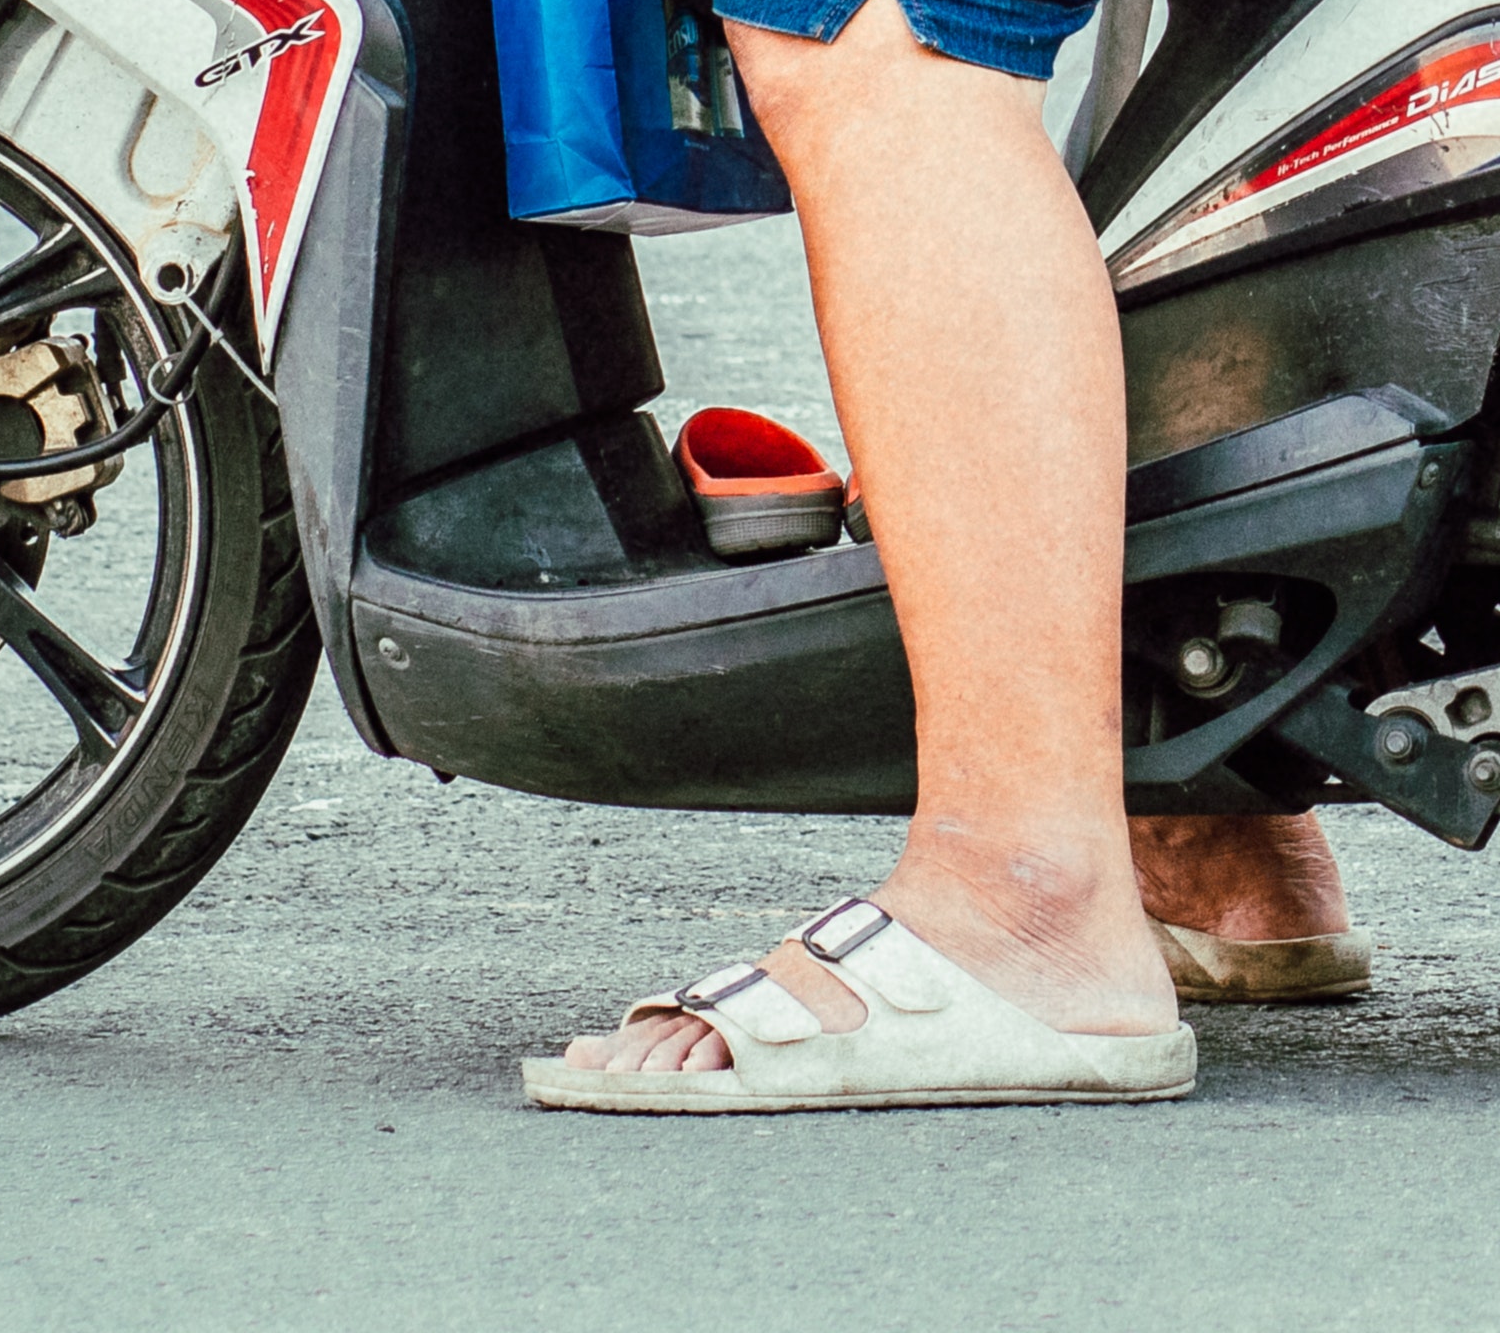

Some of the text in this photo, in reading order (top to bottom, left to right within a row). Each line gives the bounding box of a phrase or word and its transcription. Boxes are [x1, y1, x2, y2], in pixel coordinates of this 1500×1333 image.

[194, 8, 326, 88] GTX
[1276, 114, 1401, 177] Hi-Tech Performance
[83, 699, 215, 866] KENDA
